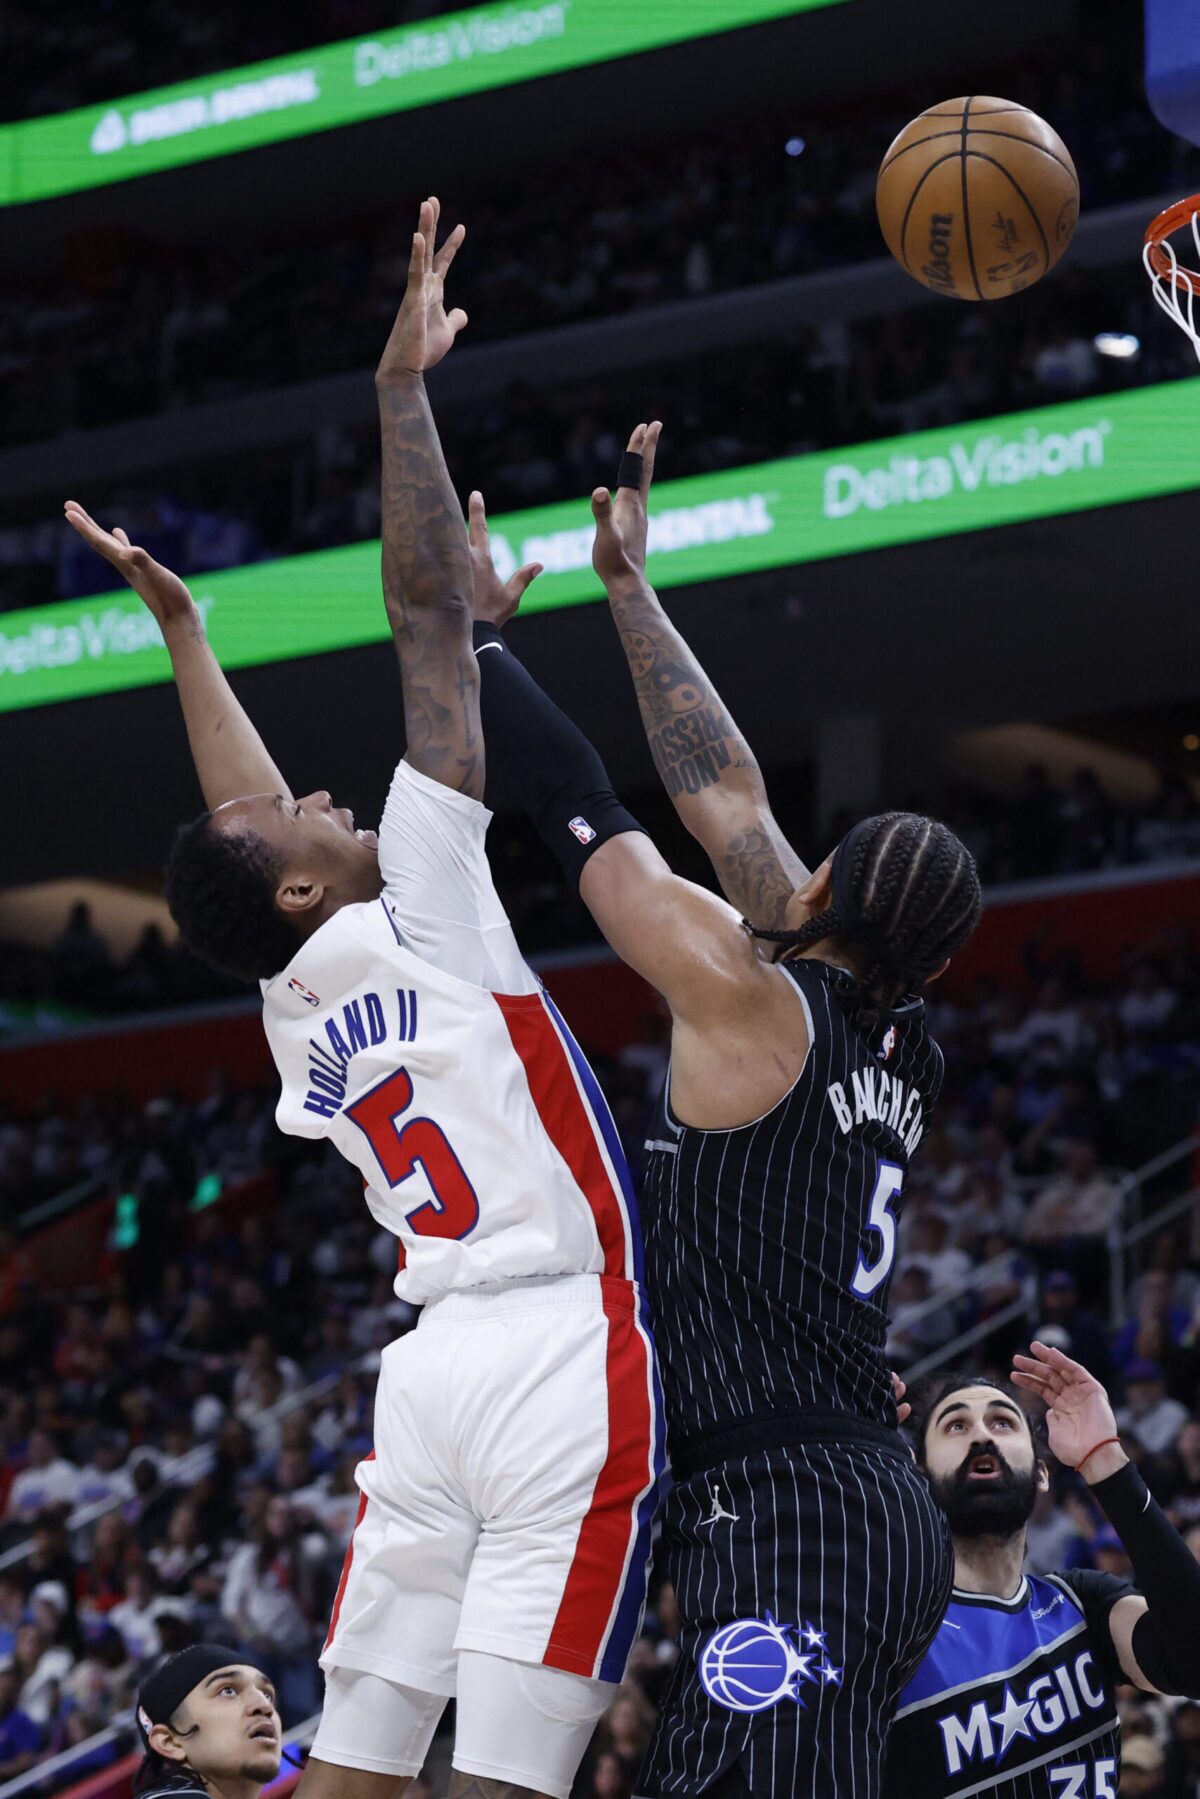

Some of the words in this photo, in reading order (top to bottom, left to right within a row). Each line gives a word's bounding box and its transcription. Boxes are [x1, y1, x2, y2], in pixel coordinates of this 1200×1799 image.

[303, 992, 388, 1119] HOLLAND
[396, 988, 417, 1043] II
[828, 1066, 923, 1162] BANCHER
[342, 1065, 480, 1241] 5
[850, 1159, 904, 1299] 5
